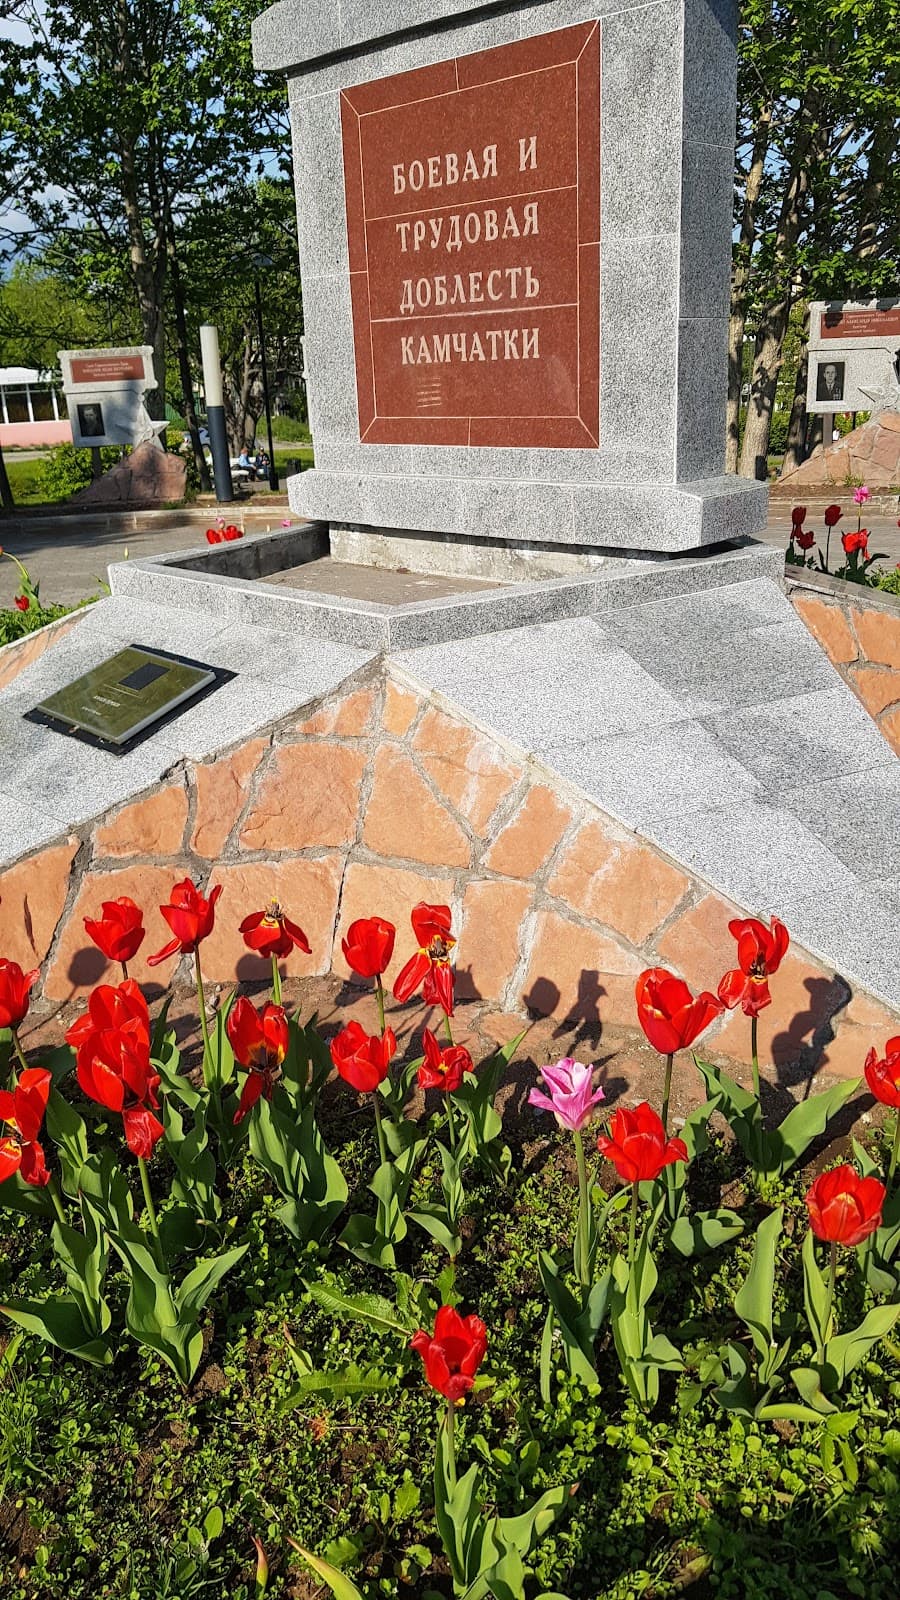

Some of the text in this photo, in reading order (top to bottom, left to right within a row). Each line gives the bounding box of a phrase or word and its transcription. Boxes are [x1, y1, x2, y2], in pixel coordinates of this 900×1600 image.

[393, 136, 538, 195] БОЕВАЯ И
[396, 202, 539, 252] ТРУДОВАЯ
[400, 266, 540, 314] ДОБЛЕСТЬ
[401, 328, 540, 365] КАМЧАТКИ
